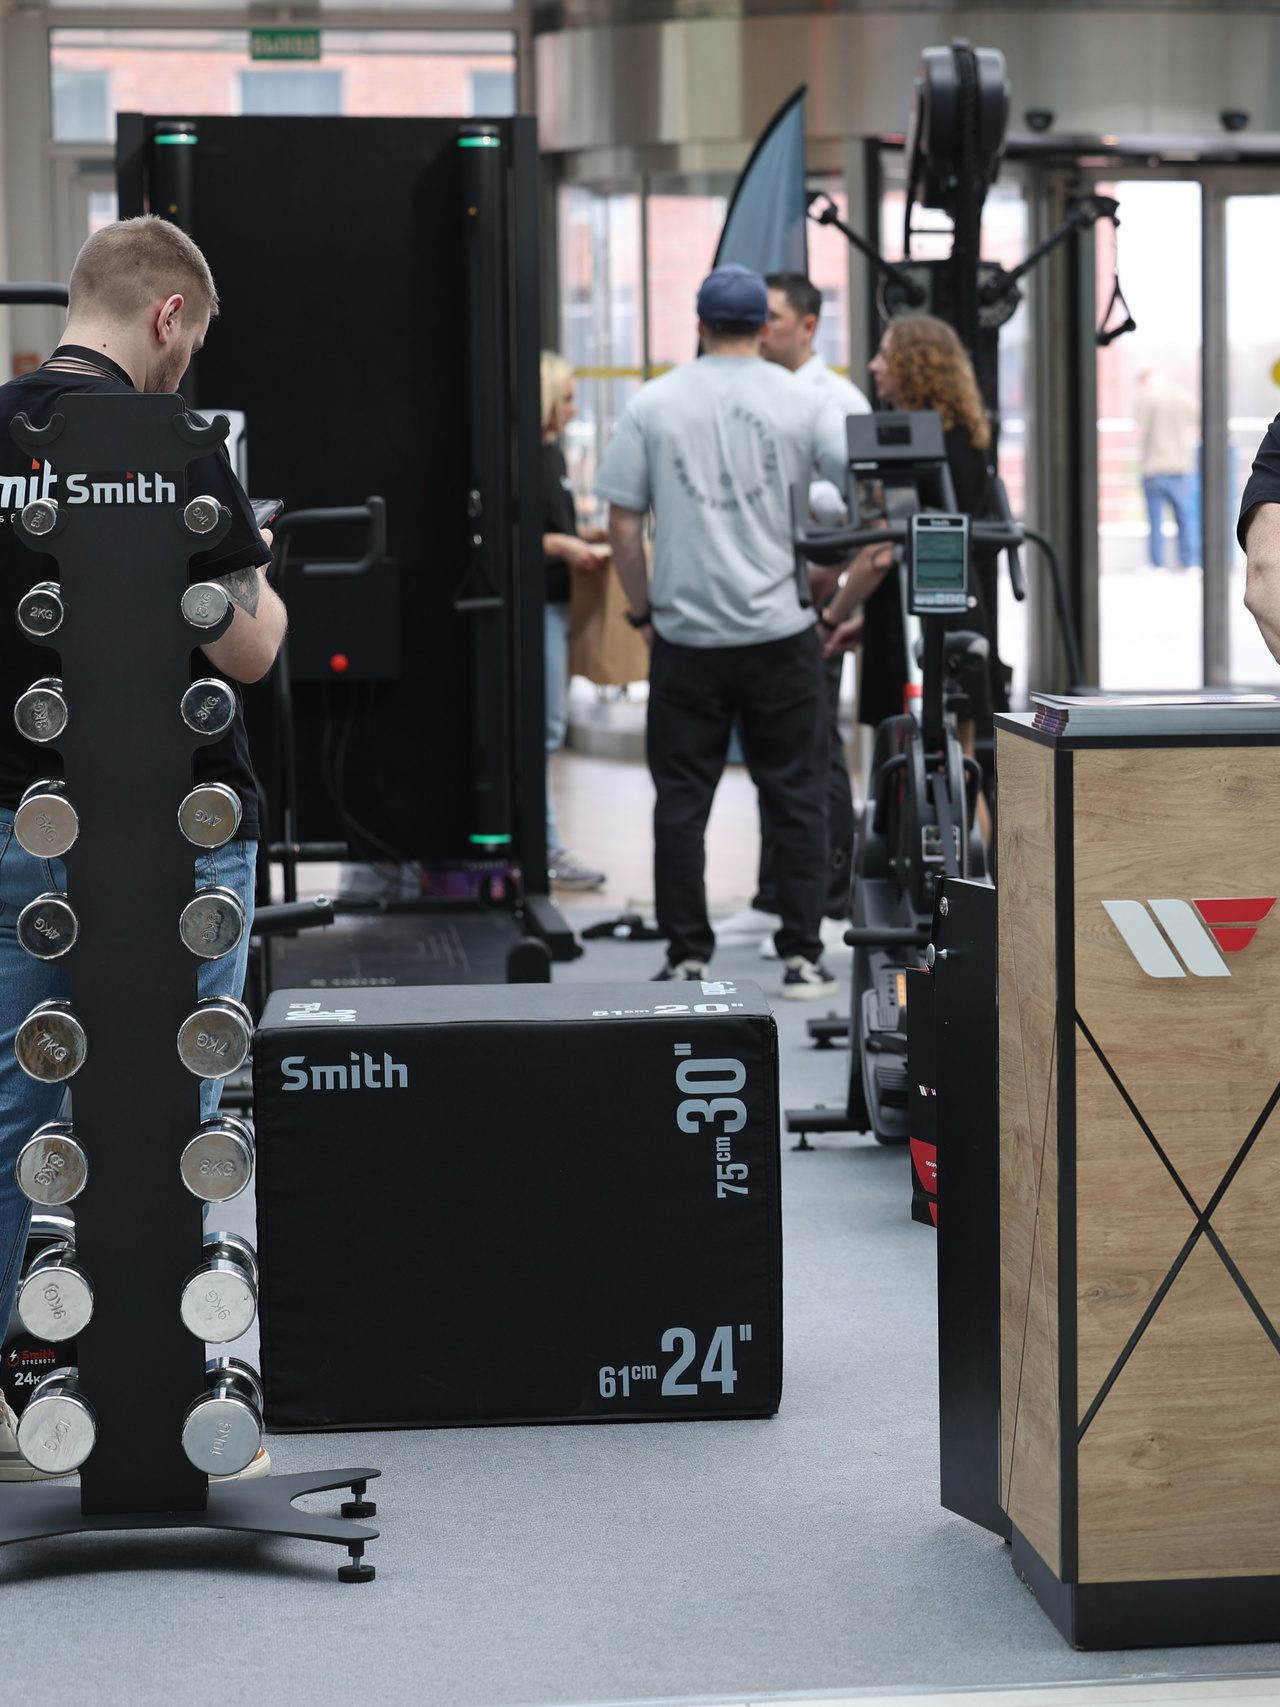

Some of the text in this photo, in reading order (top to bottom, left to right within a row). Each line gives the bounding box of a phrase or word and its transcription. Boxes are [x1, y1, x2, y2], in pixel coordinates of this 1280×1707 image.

[0, 458, 58, 508] mit
[66, 471, 176, 504] Smith
[31, 510, 46, 529] 1KG
[193, 507, 209, 525] 1KG
[30, 606, 54, 620] 2KG
[196, 592, 212, 619] 2KG
[34, 699, 50, 730] 3KG
[197, 695, 221, 720] 3KG
[35, 812, 58, 843] 5KG
[194, 809, 223, 828] 4KG
[34, 917, 61, 940] 4KG
[37, 1032, 67, 1061] 7KG
[196, 1032, 228, 1057] 7KG
[281, 1051, 409, 1091] Smith
[674, 1043, 748, 1198] 75cm 30"
[199, 1159, 236, 1178] 8KG
[205, 1289, 231, 1320] 9KG
[22, 1349, 55, 1360] Smith
[22, 1358, 56, 1366] STRENGTH
[599, 1324, 752, 1398] 61cm 24"
[15, 1371, 46, 1386] 24K
[43, 1419, 71, 1452] 10KG
